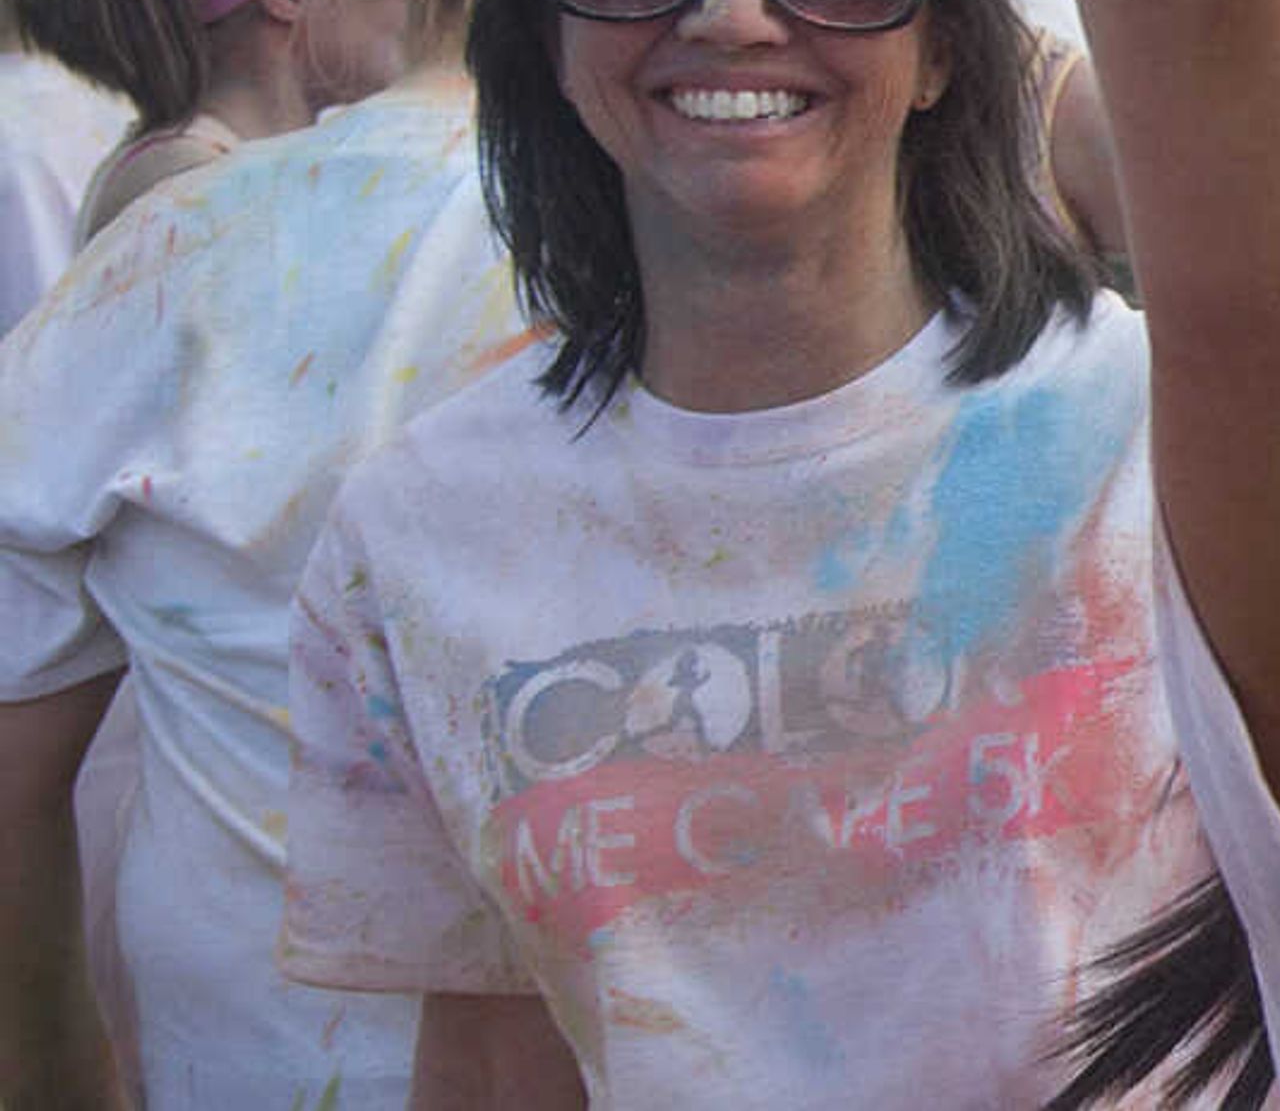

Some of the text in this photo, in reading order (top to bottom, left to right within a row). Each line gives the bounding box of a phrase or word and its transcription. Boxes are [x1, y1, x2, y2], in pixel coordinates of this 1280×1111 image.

[503, 625, 1030, 781] COLO
[515, 795, 637, 893] ME
[968, 732, 1075, 825] 5K
